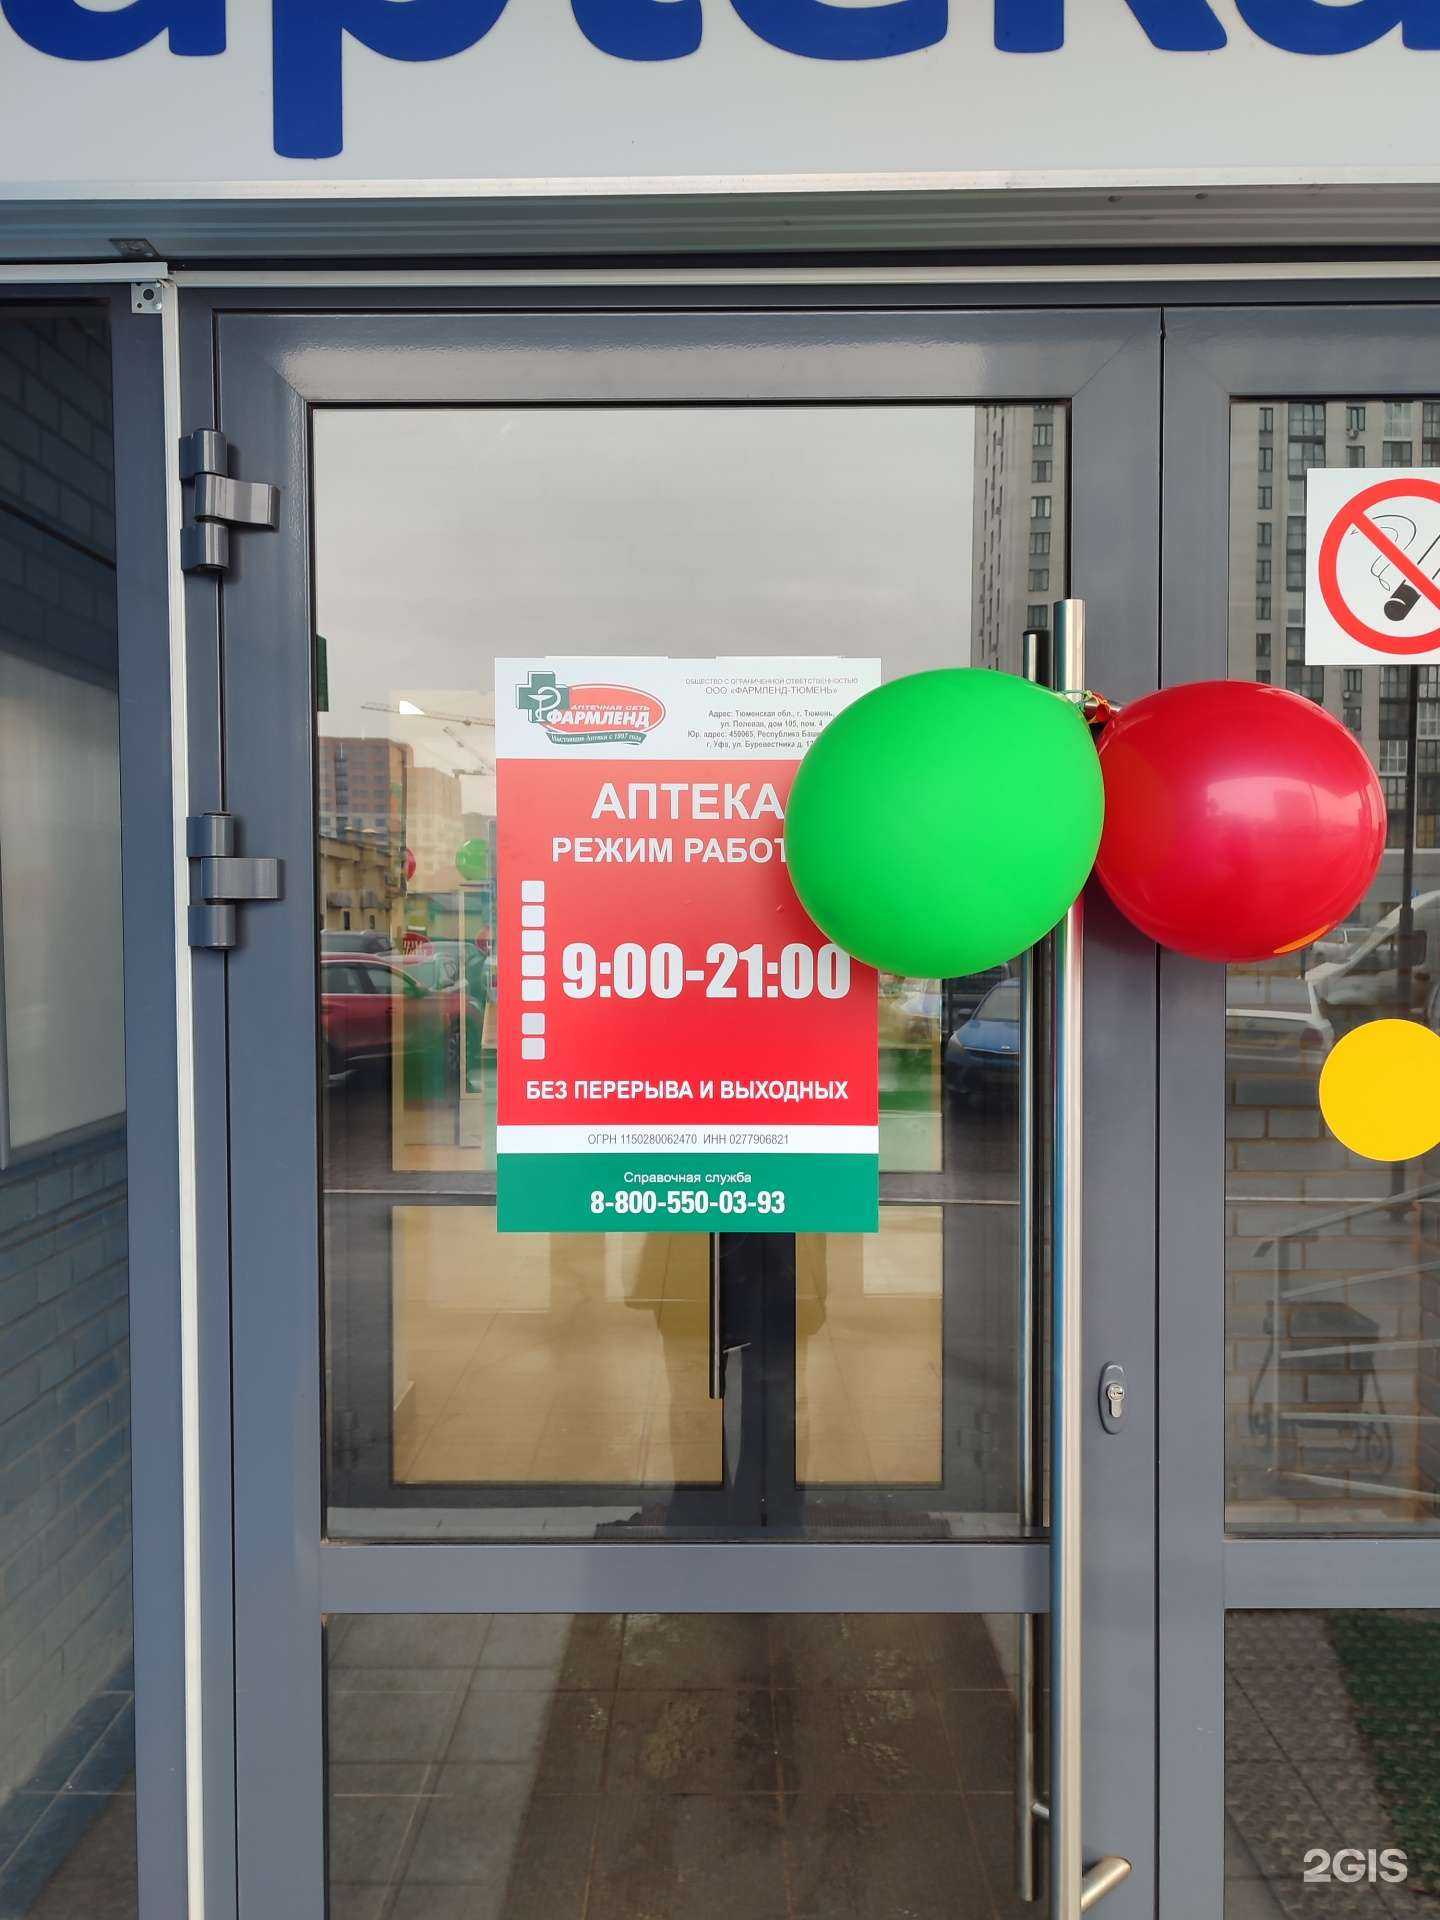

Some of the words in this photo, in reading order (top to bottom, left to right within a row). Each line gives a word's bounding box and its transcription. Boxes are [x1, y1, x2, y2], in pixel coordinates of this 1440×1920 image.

[705, 686, 728, 695] ООО
[731, 686, 838, 696] «ФАРМЛЕНД-ТЮМЕНЬ»
[546, 709, 650, 728] ФАРМЛЕНД
[708, 710, 733, 719] Адрес:
[735, 710, 776, 718] Тюменская
[784, 720, 799, 728] 105,
[757, 729, 800, 739] Республика
[591, 782, 784, 820] АПТЕКА
[551, 837, 673, 863] РЕЖИМ
[684, 837, 786, 863] РАБОТ
[561, 942, 852, 999] 9:00-21:00
[526, 1080, 568, 1100] БЕЗ
[573, 1080, 694, 1100] ПЕРЕРЫВА
[699, 1080, 714, 1100] И
[720, 1080, 848, 1103] ВЫХОДНЫХ
[587, 1133, 618, 1146] ОГРН
[620, 1133, 698, 1145] 1150280062470
[703, 1133, 727, 1145] ИНН
[729, 1133, 790, 1145] 0277906821
[623, 1172, 702, 1186] Справочная
[704, 1171, 753, 1186] служба
[590, 1190, 786, 1215] 8-800-550-03-93
